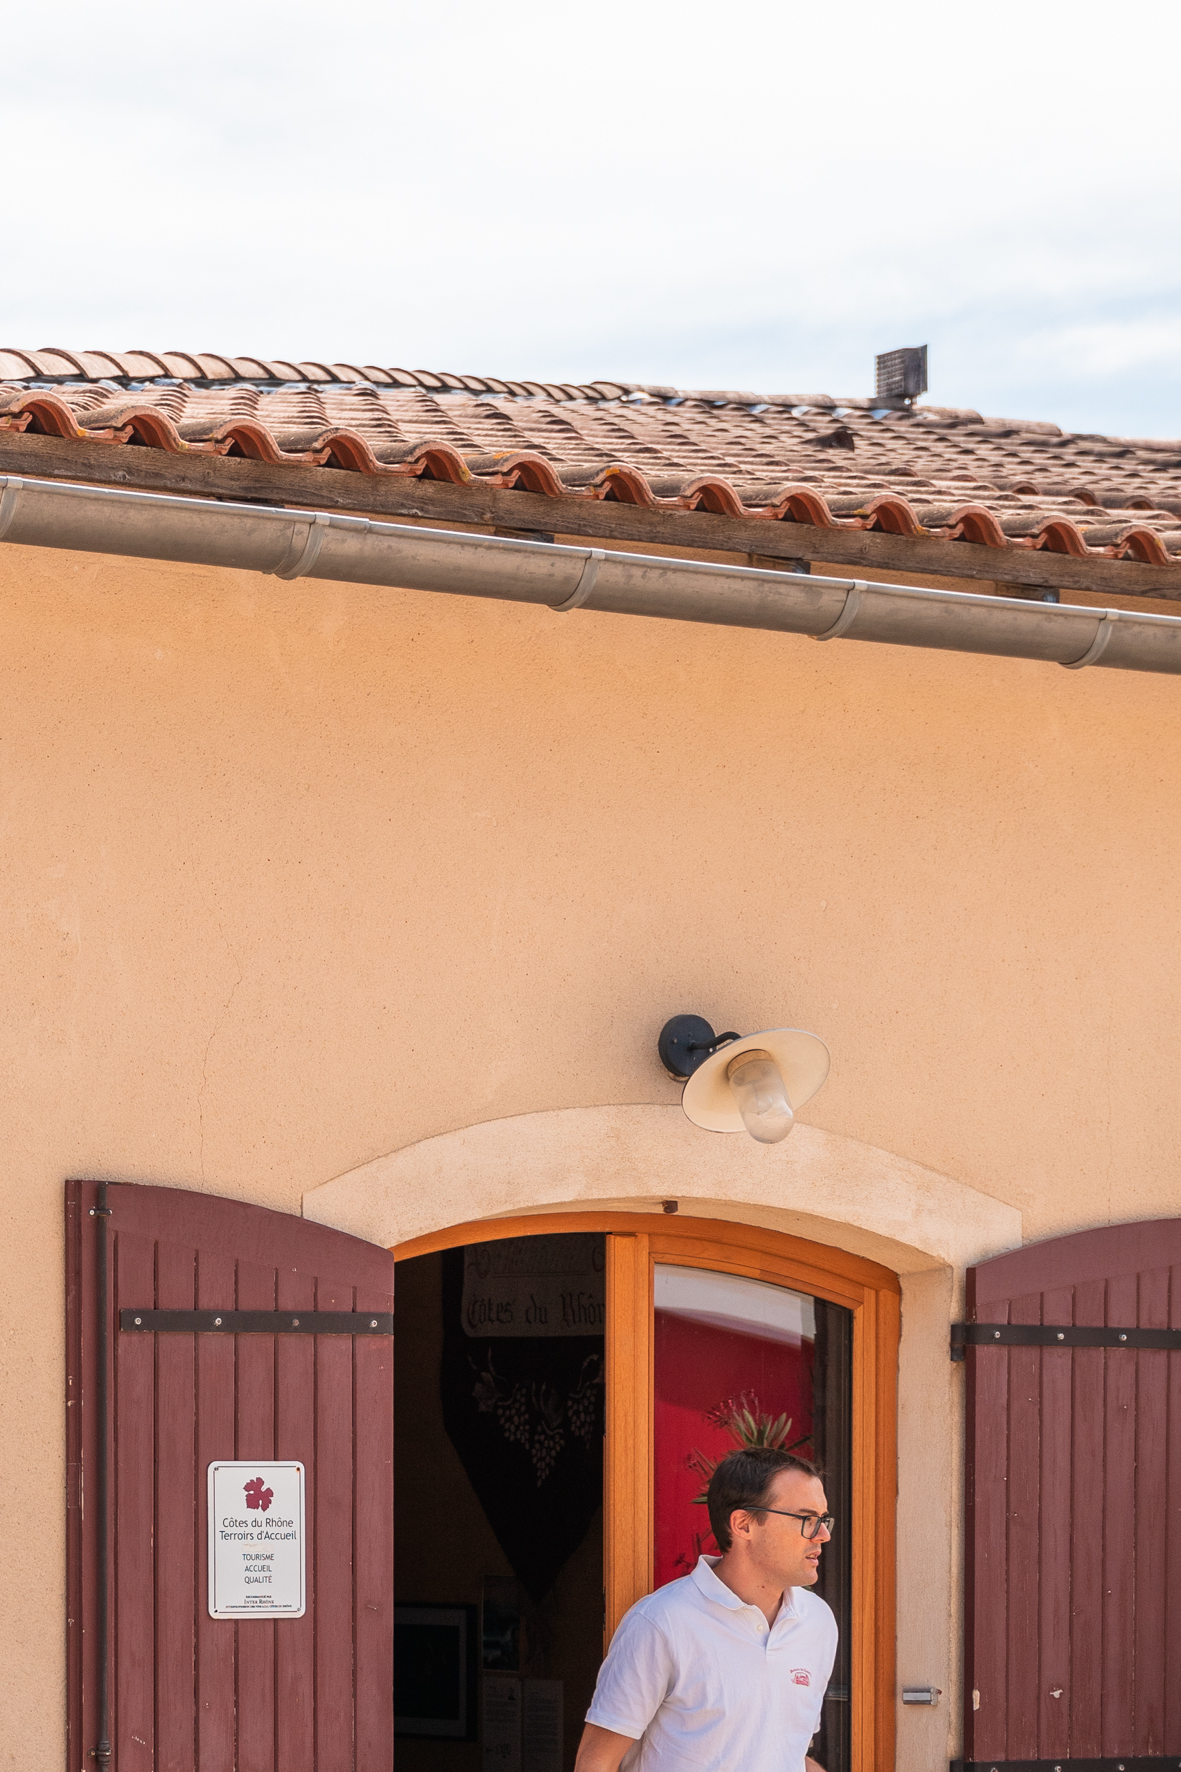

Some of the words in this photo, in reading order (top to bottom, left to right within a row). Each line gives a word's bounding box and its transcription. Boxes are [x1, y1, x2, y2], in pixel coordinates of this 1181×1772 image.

[525, 1294, 549, 1325] du
[559, 1291, 605, 1328] Rhôn
[222, 1516, 249, 1528] Côtes
[250, 1517, 263, 1528] du
[265, 1516, 294, 1528] Rhône
[219, 1530, 254, 1541] Terroirs
[256, 1530, 297, 1541] d'Accueil
[242, 1553, 275, 1561] TOURISME
[244, 1564, 273, 1573] ACCUEIL
[244, 1575, 273, 1584] QUALITÉ
